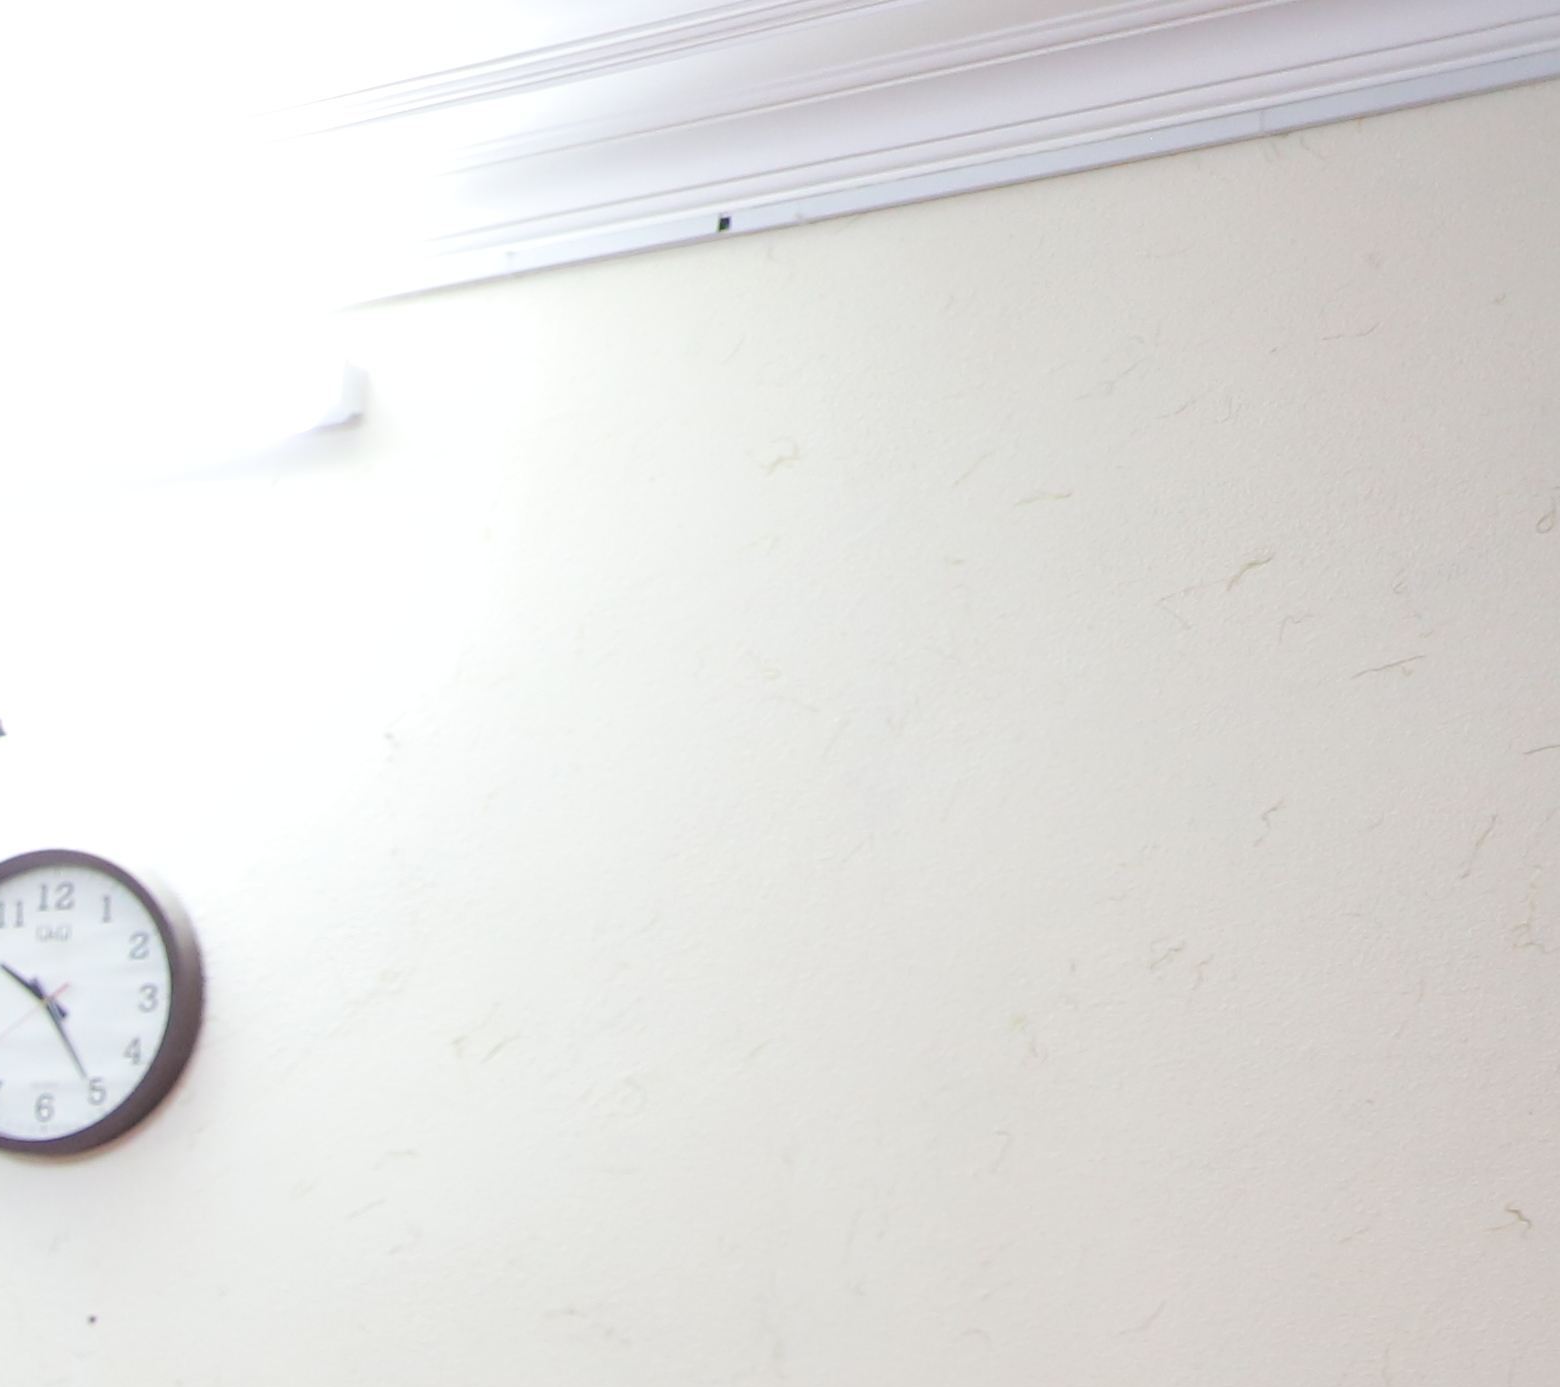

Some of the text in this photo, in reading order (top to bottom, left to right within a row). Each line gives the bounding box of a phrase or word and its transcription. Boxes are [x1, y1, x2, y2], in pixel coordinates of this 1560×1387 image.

[35, 882, 76, 911] 12
[101, 895, 113, 923] 1
[129, 933, 150, 960] 2
[138, 985, 159, 1013] 3
[123, 1037, 143, 1065] 4
[87, 1078, 107, 1106] 5
[34, 1093, 55, 1122] 6
